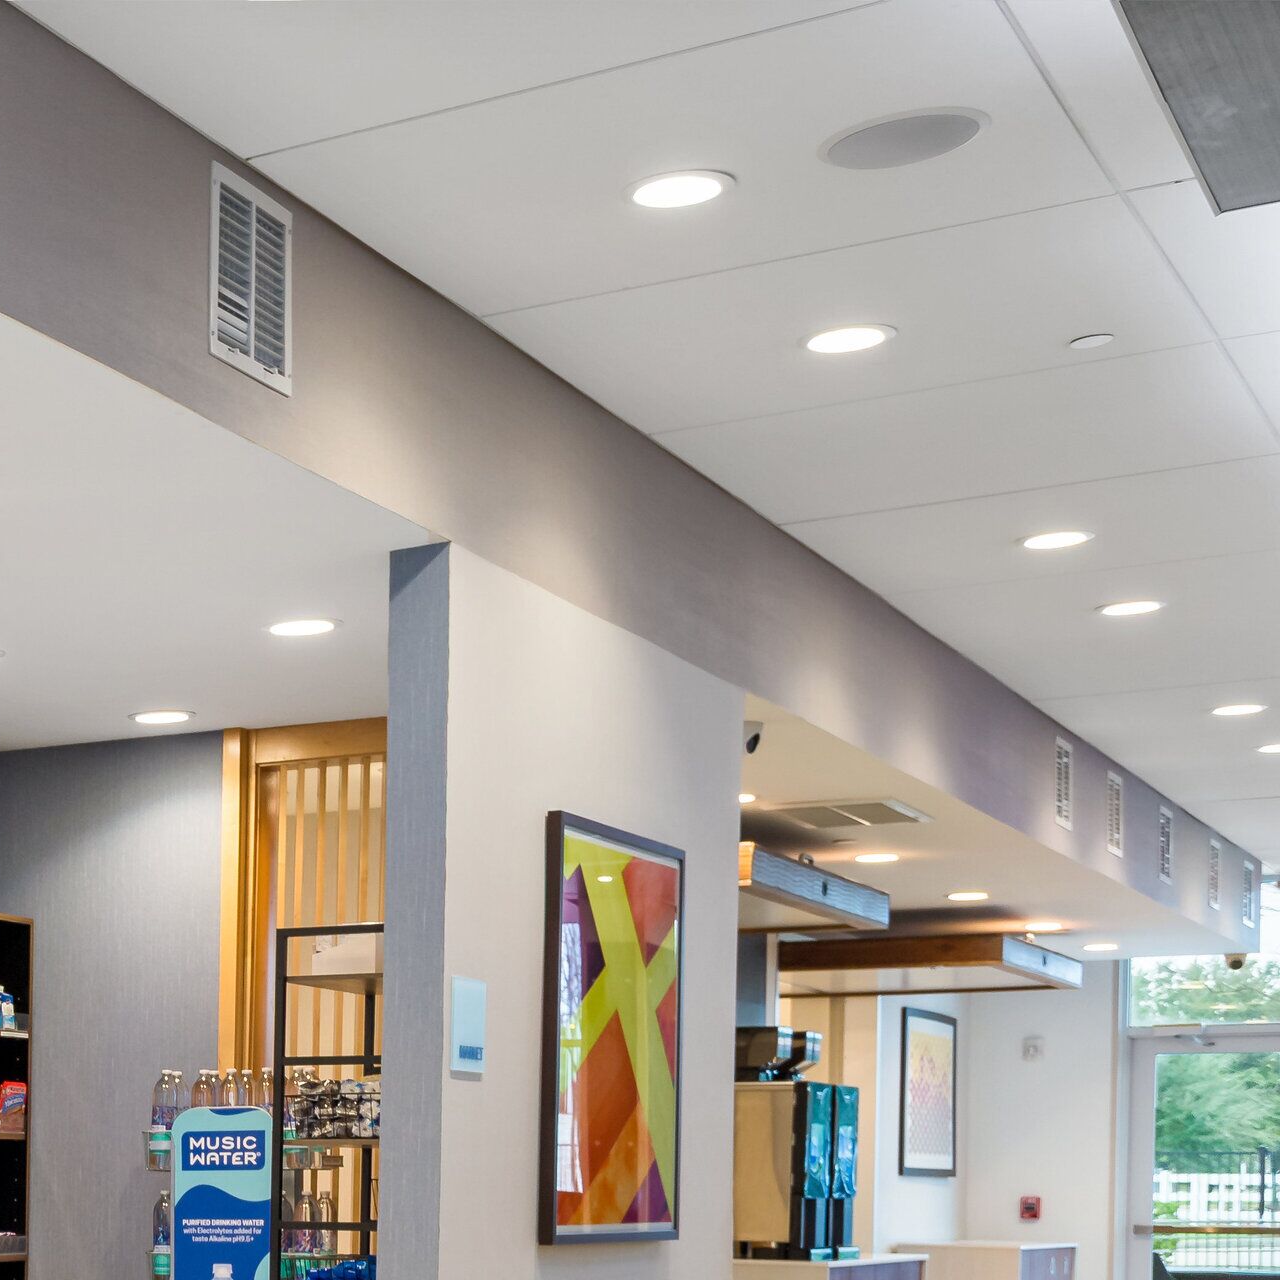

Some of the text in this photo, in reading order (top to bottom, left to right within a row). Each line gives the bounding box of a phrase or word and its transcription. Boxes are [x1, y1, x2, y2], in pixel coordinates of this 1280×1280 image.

[188, 1135, 258, 1151] MUSIC
[188, 1151, 258, 1166] WATER
[182, 1218, 265, 1227] PURIFIED DRINKING WATER
[182, 1226, 262, 1236] with Electrolytes added for
[191, 1235, 209, 1243] taste
[208, 1235, 232, 1243] Alkaline
